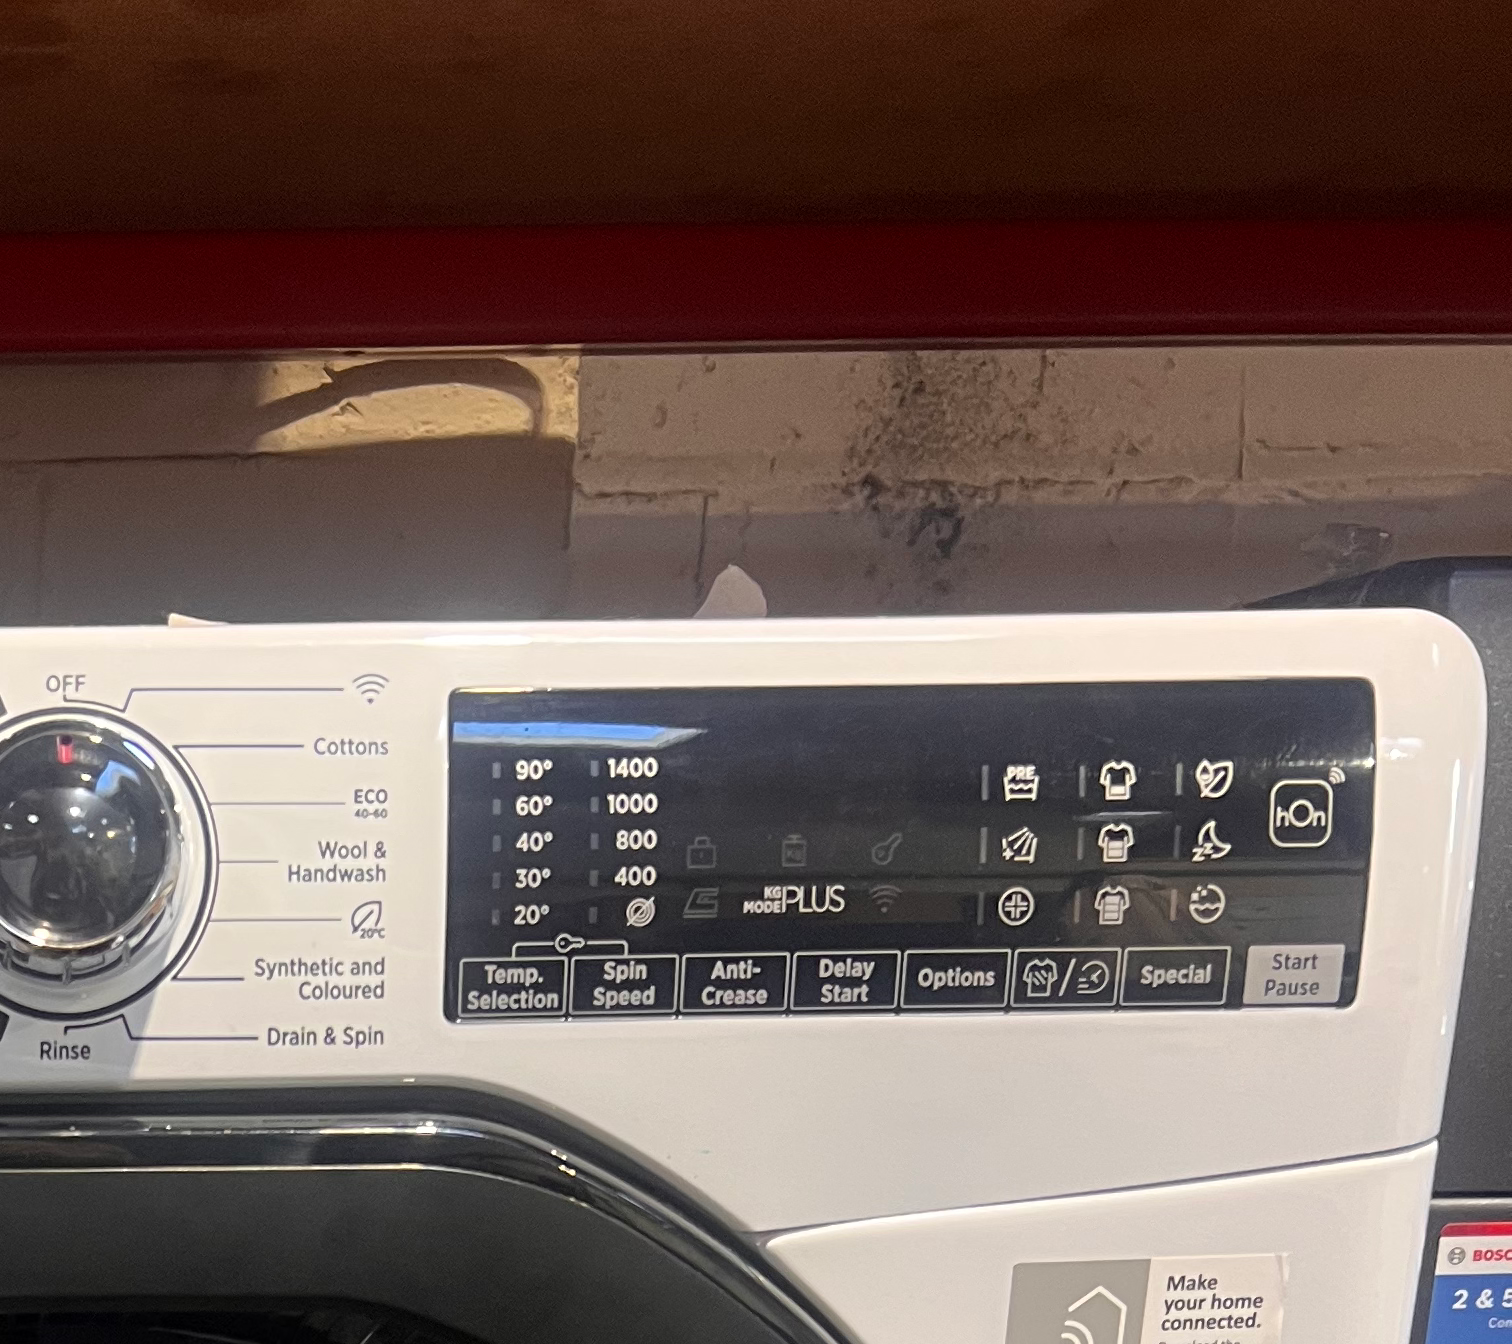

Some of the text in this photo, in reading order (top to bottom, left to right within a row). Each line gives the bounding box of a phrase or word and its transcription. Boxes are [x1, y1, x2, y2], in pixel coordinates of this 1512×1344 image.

[46, 675, 86, 692] OFF
[314, 737, 388, 755] Cottons
[516, 759, 553, 780] 90°
[607, 757, 658, 778] 1400
[1007, 766, 1035, 779] PRE
[354, 789, 388, 804] ECO
[516, 795, 553, 816] 60°
[607, 793, 658, 814] 1000
[354, 809, 387, 818] 40-60
[1276, 799, 1326, 828] hOn
[516, 831, 553, 852] 40°
[616, 829, 657, 850] 800
[318, 841, 386, 859] Wool &
[288, 864, 386, 882] Handwash
[515, 868, 551, 888] 30°
[615, 865, 657, 886] 400
[764, 886, 782, 899] KG
[782, 885, 845, 913] PLUS
[514, 904, 549, 925] 20°
[743, 901, 781, 914] MODE
[254, 957, 385, 980] Synthetic and
[603, 961, 647, 981] Spin
[711, 960, 761, 980] Anti-
[818, 959, 875, 981] Delay
[1271, 954, 1318, 970] Start
[485, 965, 544, 986] Temp.
[917, 967, 995, 989] Options
[1141, 965, 1212, 987] Special
[299, 981, 384, 1000] Coloured
[593, 987, 655, 1008] Speed
[702, 986, 768, 1006] Crease
[821, 984, 868, 1003] Start
[1264, 979, 1320, 997] Pause
[467, 989, 558, 1010] Selection
[267, 1026, 384, 1049] Drain & Spin
[40, 1040, 90, 1060] Rinse
[1167, 1274, 1218, 1291] Make
[1165, 1293, 1264, 1315] your home
[1452, 1290, 1468, 1309] 2
[1475, 1289, 1494, 1309] &
[1161, 1312, 1261, 1331] connected.
